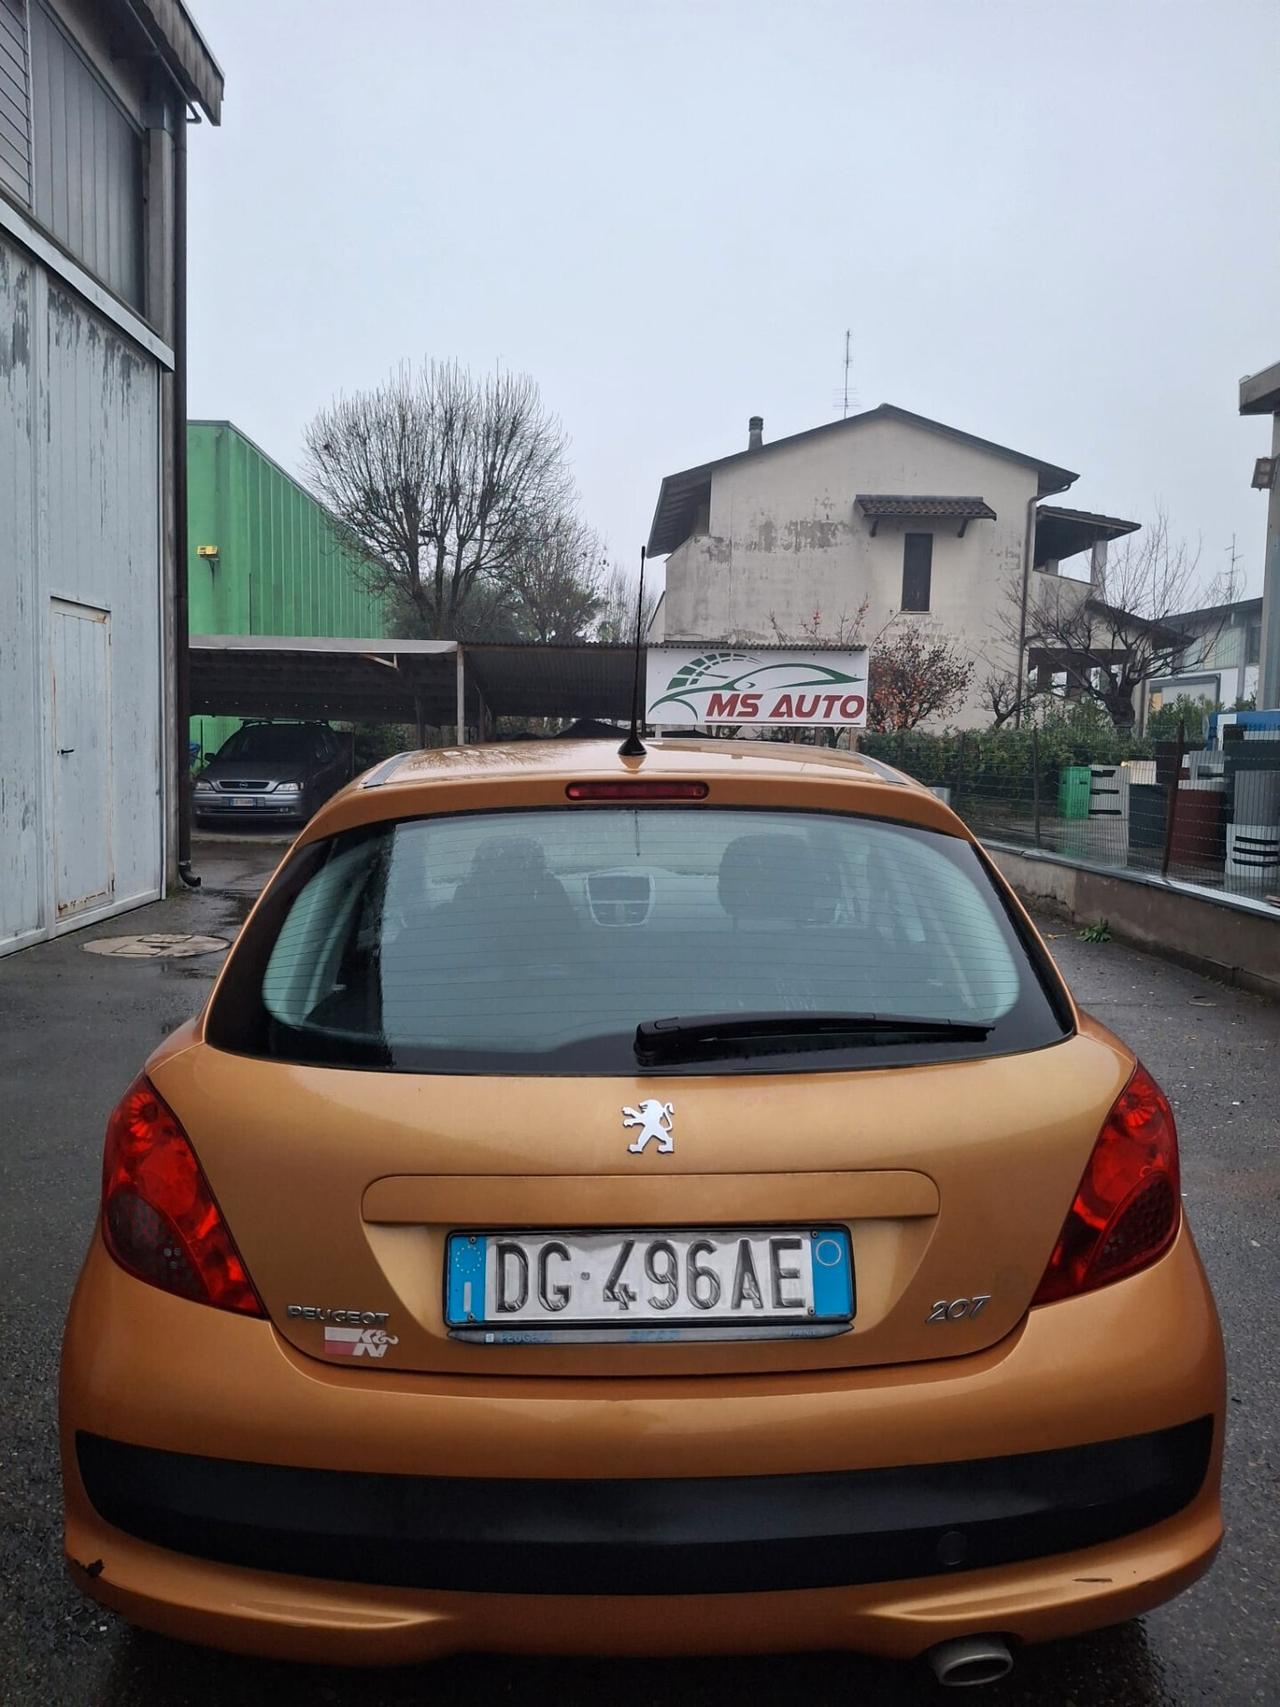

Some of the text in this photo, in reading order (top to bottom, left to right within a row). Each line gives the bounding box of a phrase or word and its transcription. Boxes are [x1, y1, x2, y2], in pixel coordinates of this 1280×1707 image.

[705, 693, 865, 719] MS AUTO
[495, 1239, 572, 1313] DG
[286, 1305, 390, 1324] PEUGEOT
[925, 1295, 992, 1324] 207
